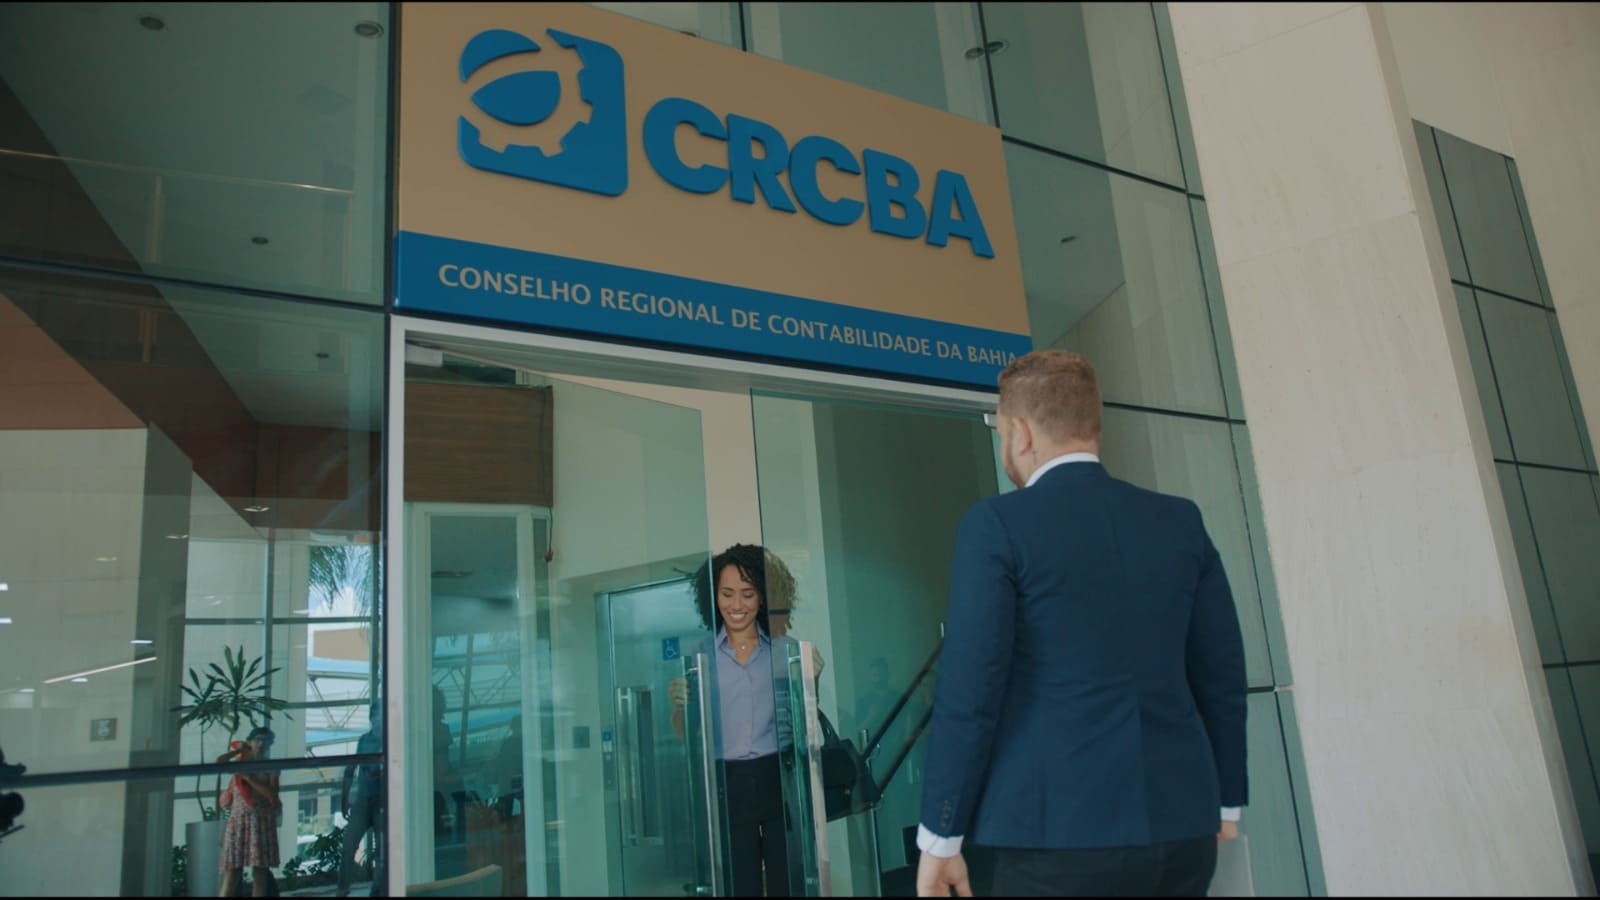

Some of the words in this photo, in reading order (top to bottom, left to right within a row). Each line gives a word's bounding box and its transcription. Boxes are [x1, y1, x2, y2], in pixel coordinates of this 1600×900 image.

[643, 97, 994, 259] CRCBA
[438, 264, 591, 305] CONSELHO
[600, 287, 724, 325] REGIONAL
[731, 308, 762, 331] DE
[768, 314, 931, 356] CONTABILIDADE
[936, 341, 963, 361] DA
[968, 345, 1017, 368] BAHIA
